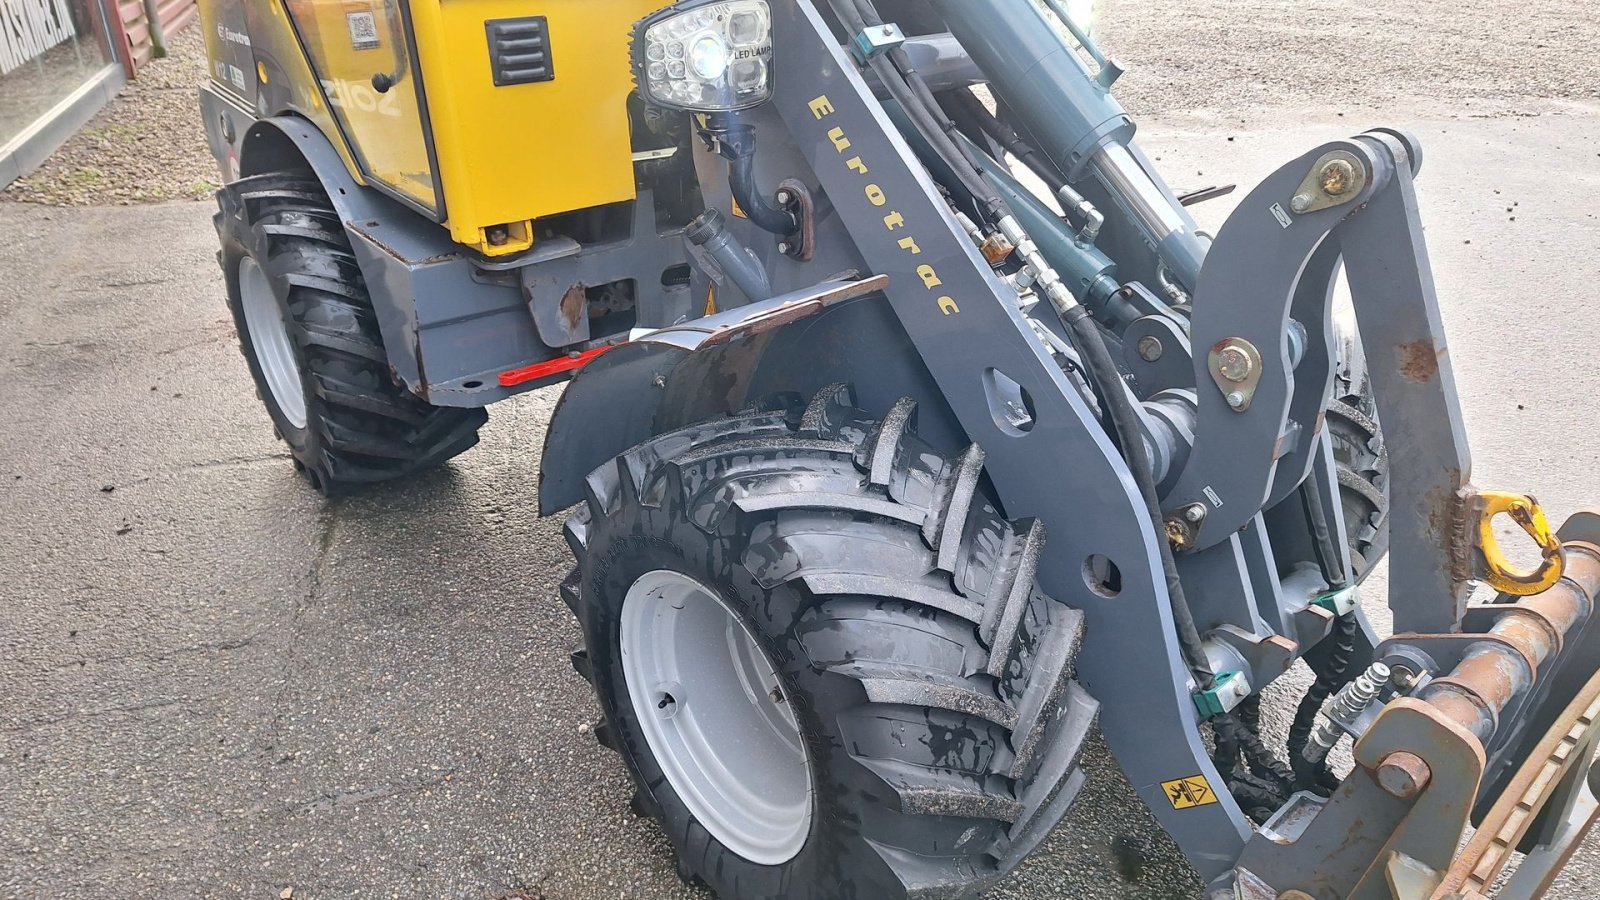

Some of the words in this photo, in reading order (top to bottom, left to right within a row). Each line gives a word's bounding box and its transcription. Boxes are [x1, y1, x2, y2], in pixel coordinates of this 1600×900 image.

[225, 27, 251, 46] Eurotra
[734, 50, 750, 60] LED
[752, 46, 771, 57] LAMP
[807, 94, 960, 316] Eurotrac
